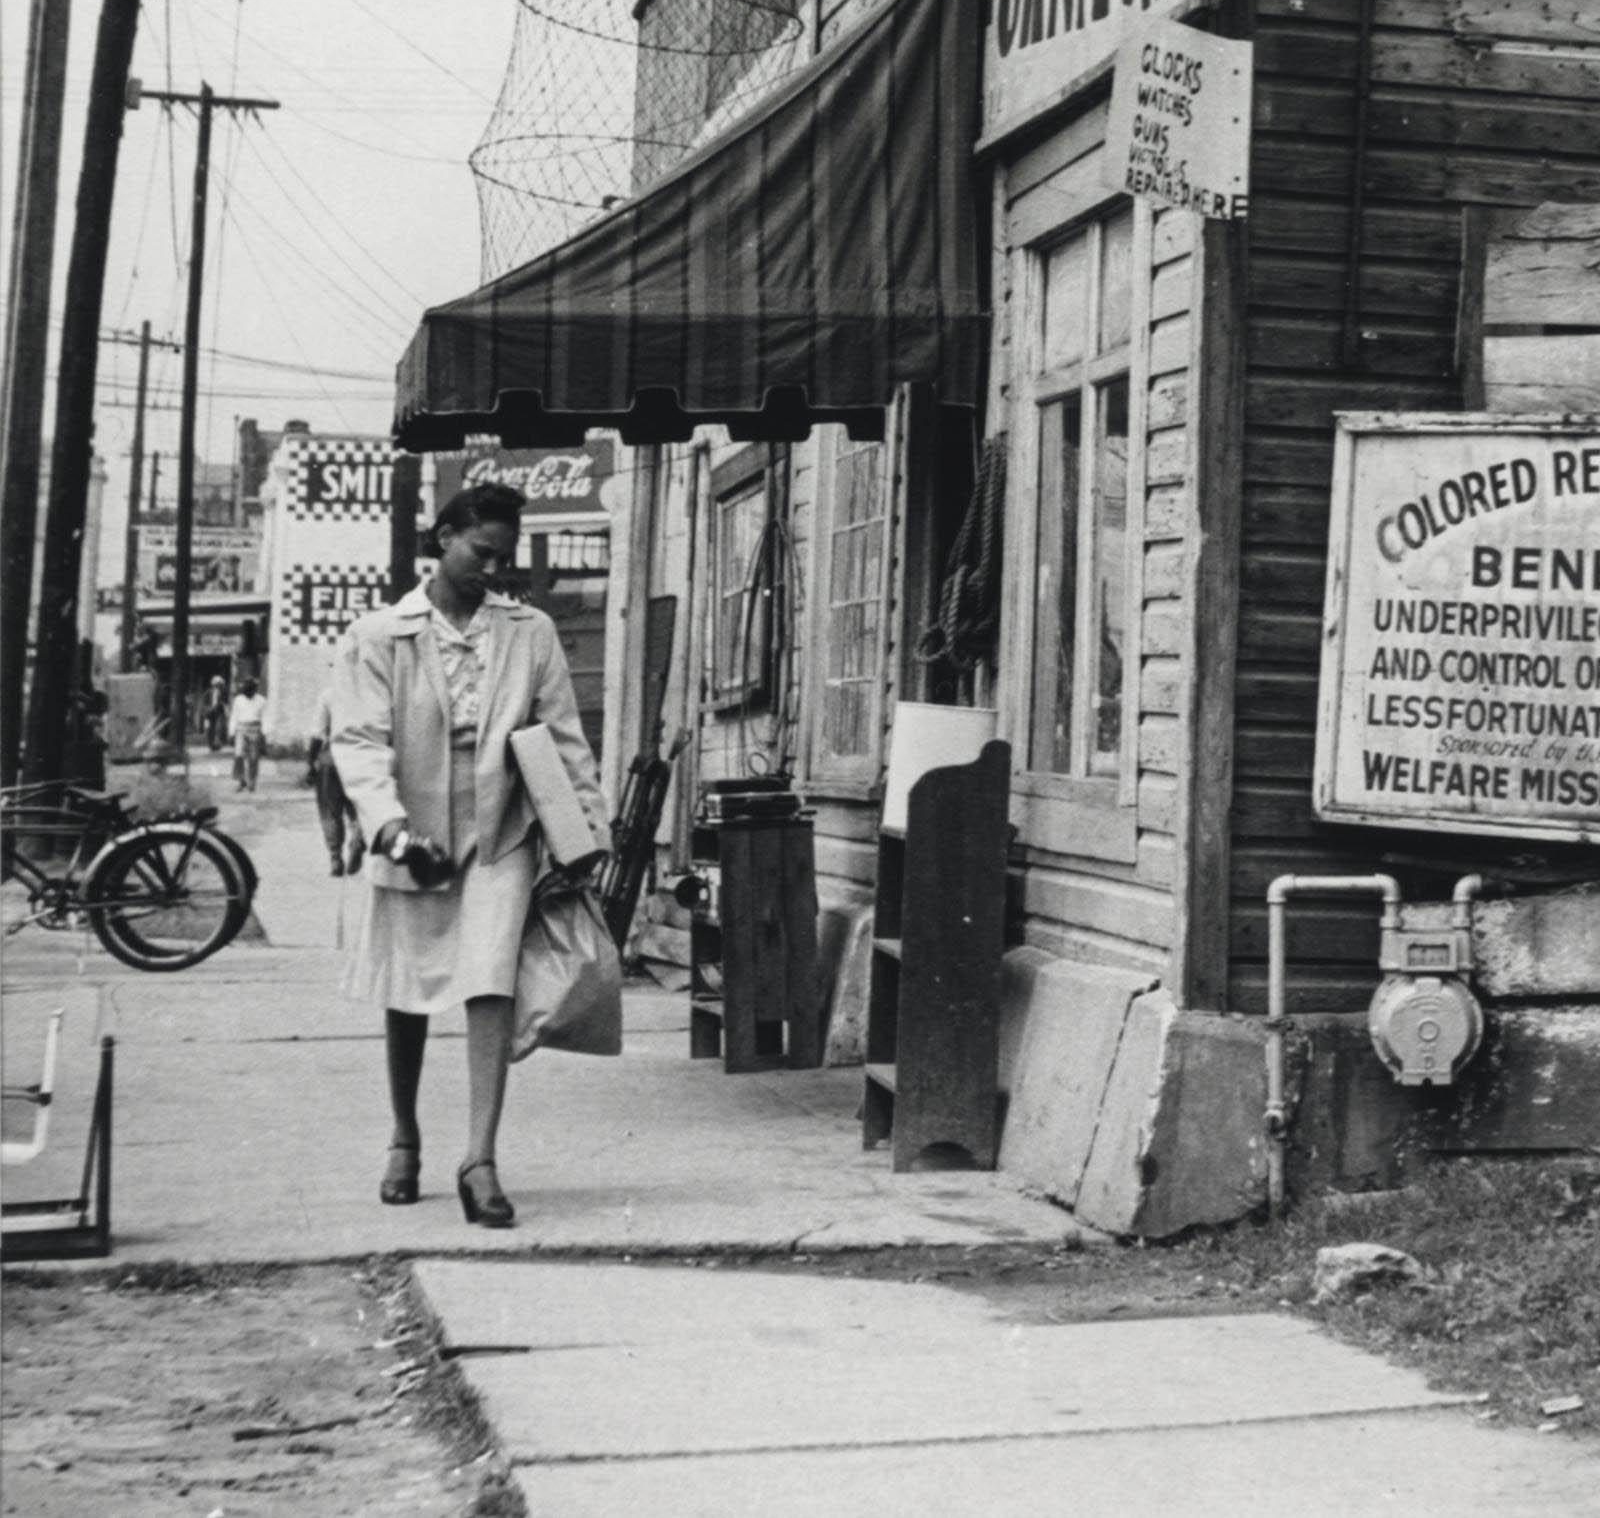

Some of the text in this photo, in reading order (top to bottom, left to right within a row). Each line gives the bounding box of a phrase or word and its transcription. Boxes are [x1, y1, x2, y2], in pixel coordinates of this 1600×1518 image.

[1141, 43, 1203, 95] CLOCKS
[1137, 82, 1193, 127] WATCHES
[1133, 113, 1170, 155] GUNS
[1191, 185, 1250, 220] HERE
[1375, 457, 1537, 565] COLORED
[1369, 647, 1432, 682] AND
[1439, 650, 1567, 690] CONTROL
[1362, 750, 1509, 800] WELFARE
[1543, 743, 1569, 765] by
